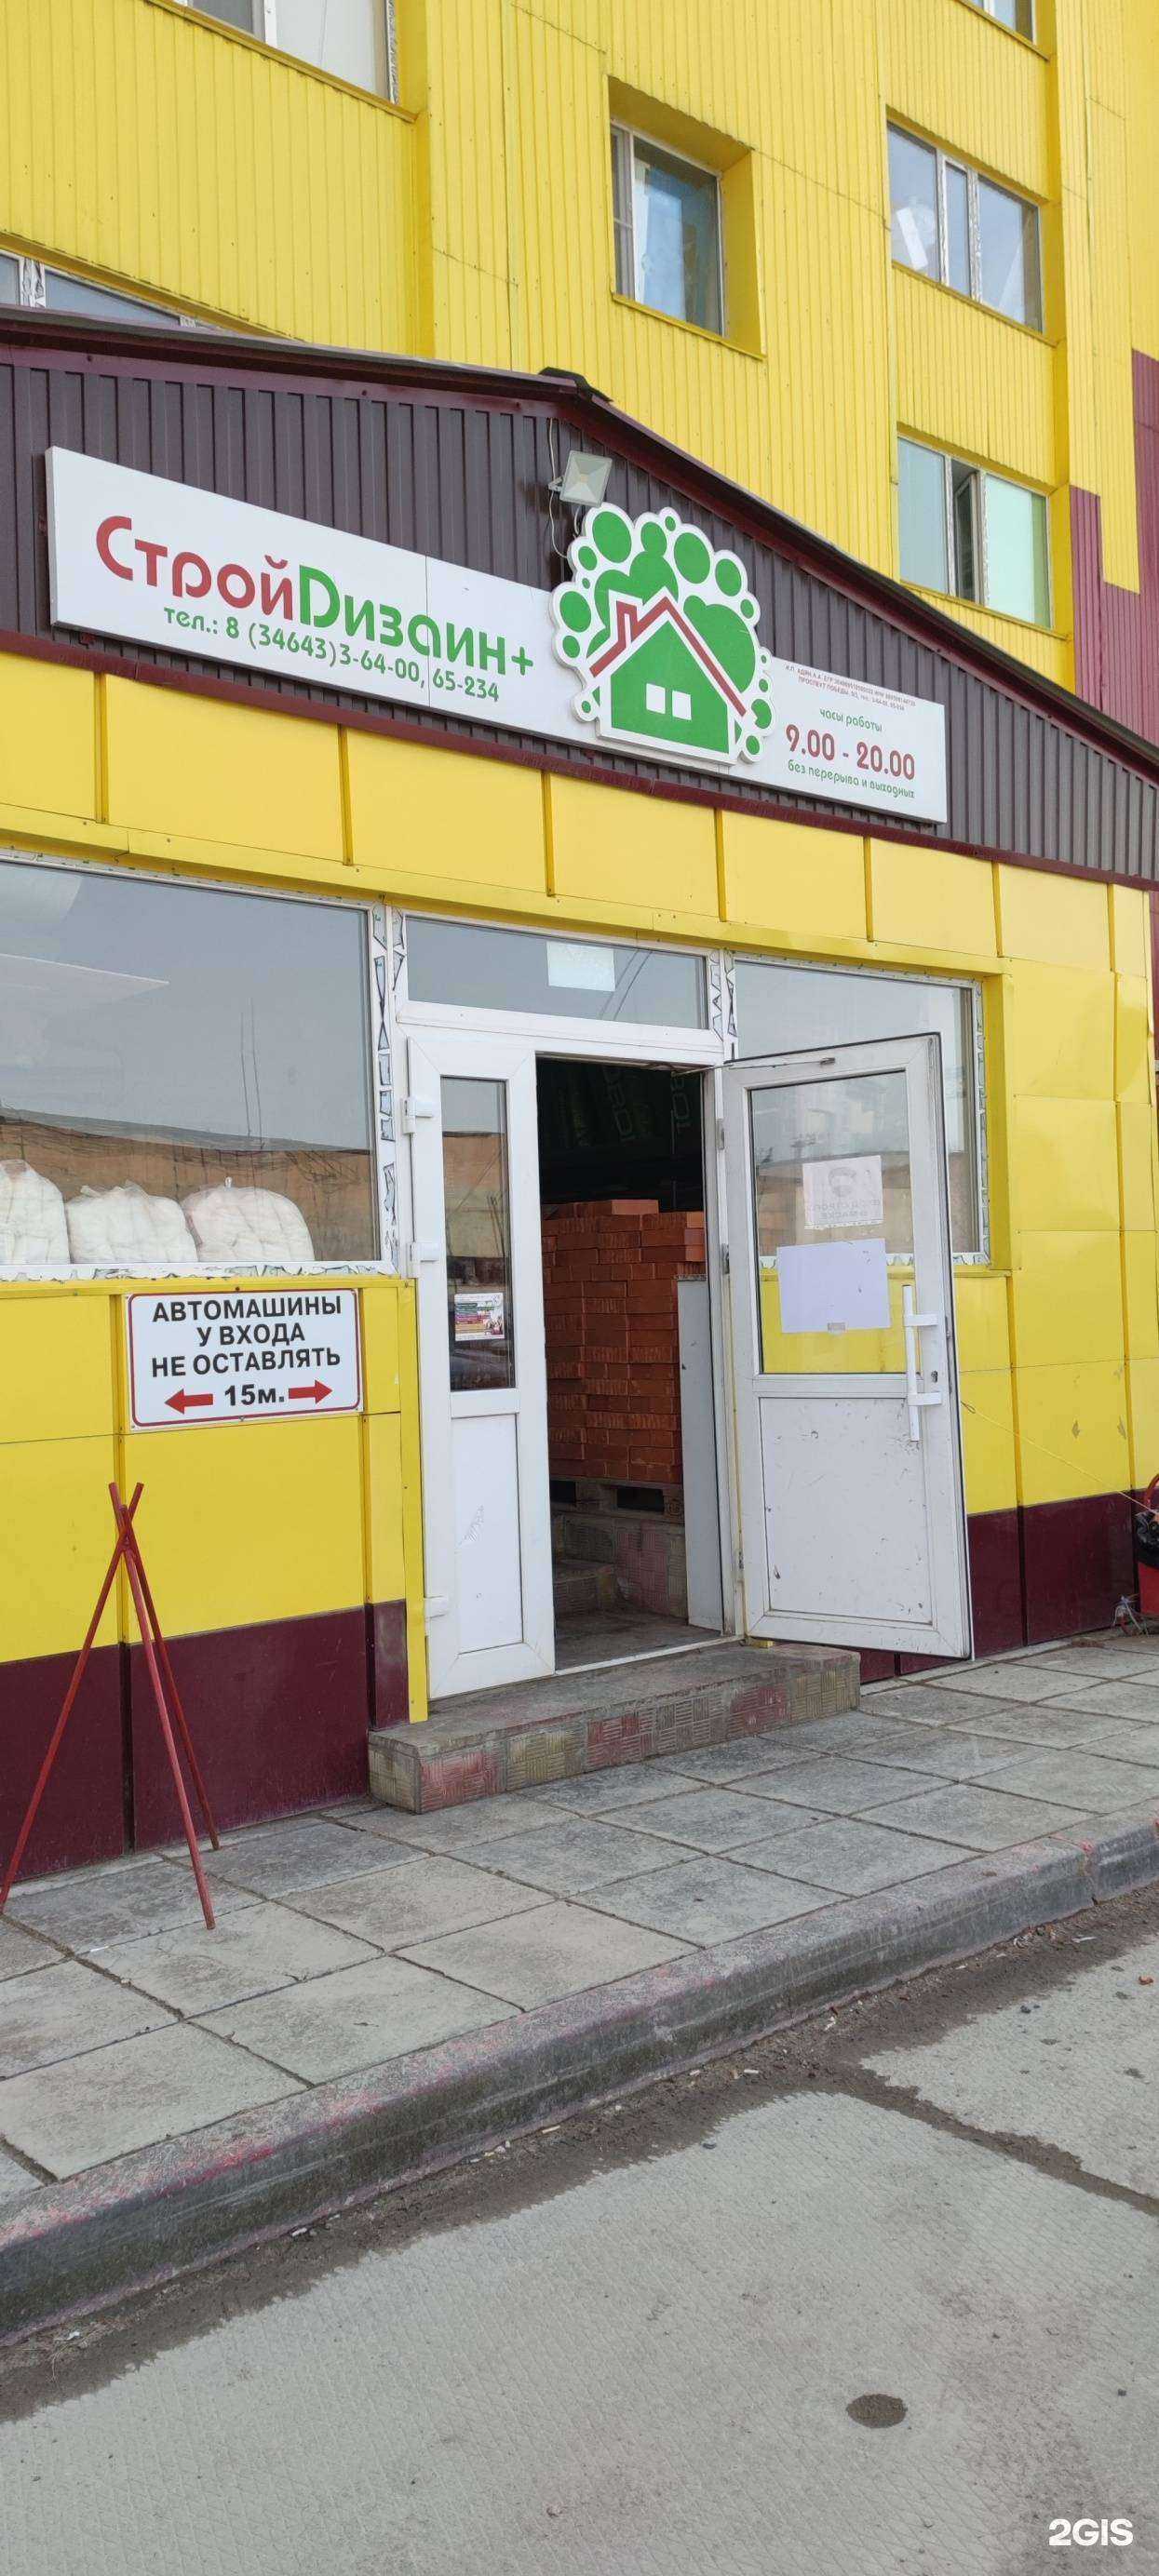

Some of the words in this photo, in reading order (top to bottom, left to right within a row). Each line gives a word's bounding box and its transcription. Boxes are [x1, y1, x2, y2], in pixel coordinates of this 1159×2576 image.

[163, 605, 219, 637] тел.:
[225, 616, 240, 639] 8
[432, 668, 500, 702] 65-234
[819, 707, 843, 722] часы
[845, 714, 883, 732] работы
[786, 724, 835, 761] 9.00
[856, 741, 915, 780] 20.00
[788, 758, 806, 774] без
[808, 768, 859, 785] перерыва
[861, 778, 869, 789] и
[869, 781, 915, 798] выходных
[152, 1295, 342, 1322] АВТОМАШИНЫ
[196, 1326, 212, 1347] У
[219, 1322, 305, 1347] ВХОДА
[151, 1355, 186, 1378] НЕ
[193, 1347, 341, 1375] ОСТАВЛЯТЬ
[224, 1383, 285, 1407] 15м.
